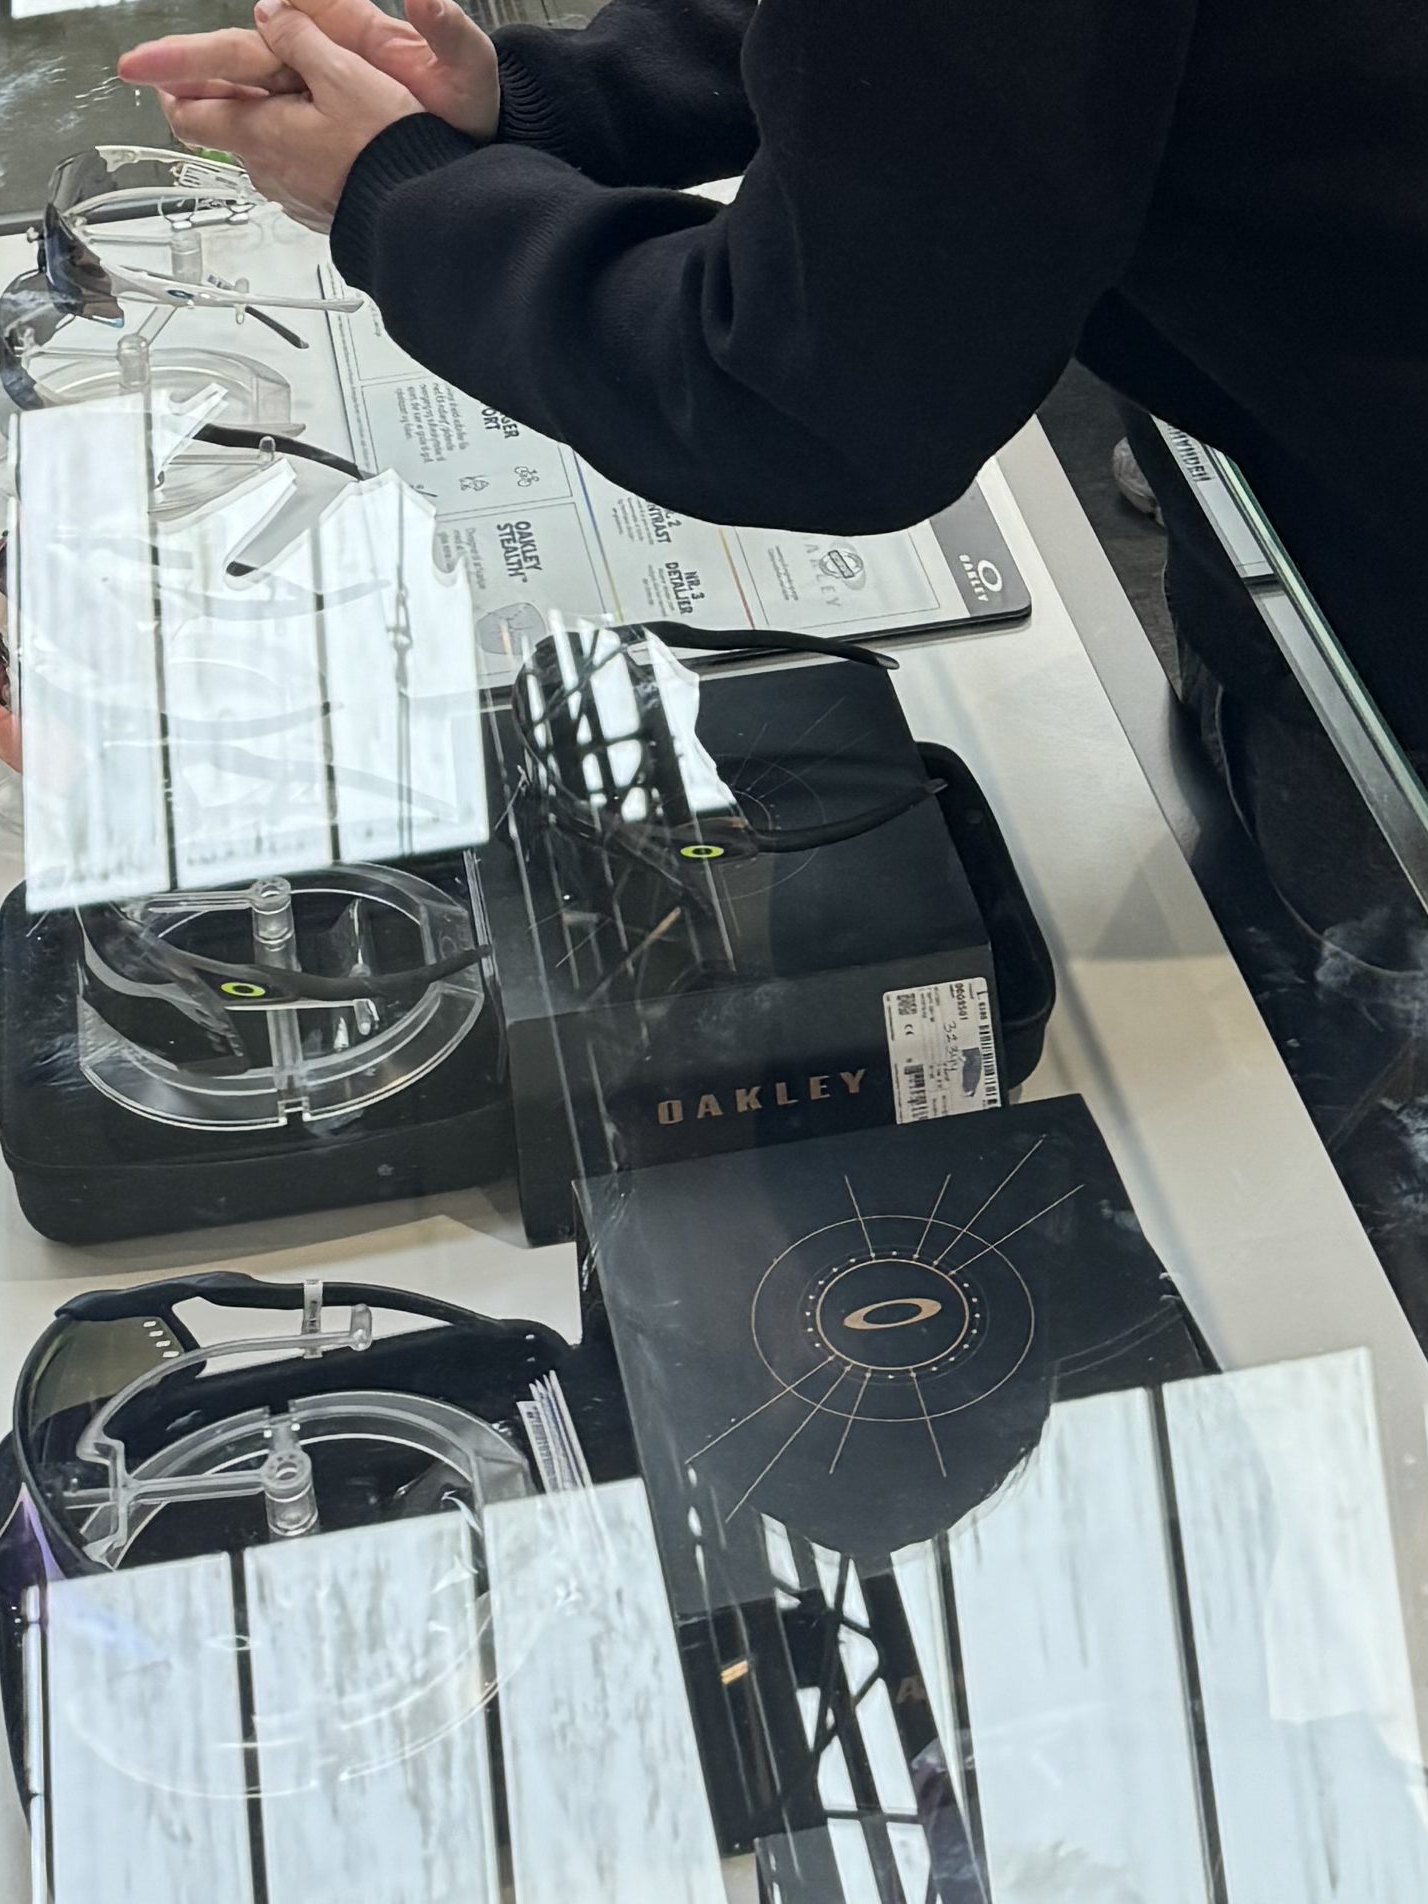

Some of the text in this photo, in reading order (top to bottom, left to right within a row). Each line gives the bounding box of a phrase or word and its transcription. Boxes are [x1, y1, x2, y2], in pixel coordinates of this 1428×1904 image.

[514, 520, 543, 572] OAKLEY
[664, 561, 694, 616] DETALJER
[958, 553, 990, 603] OAKLEY
[657, 1068, 867, 1126] OAKLEY
